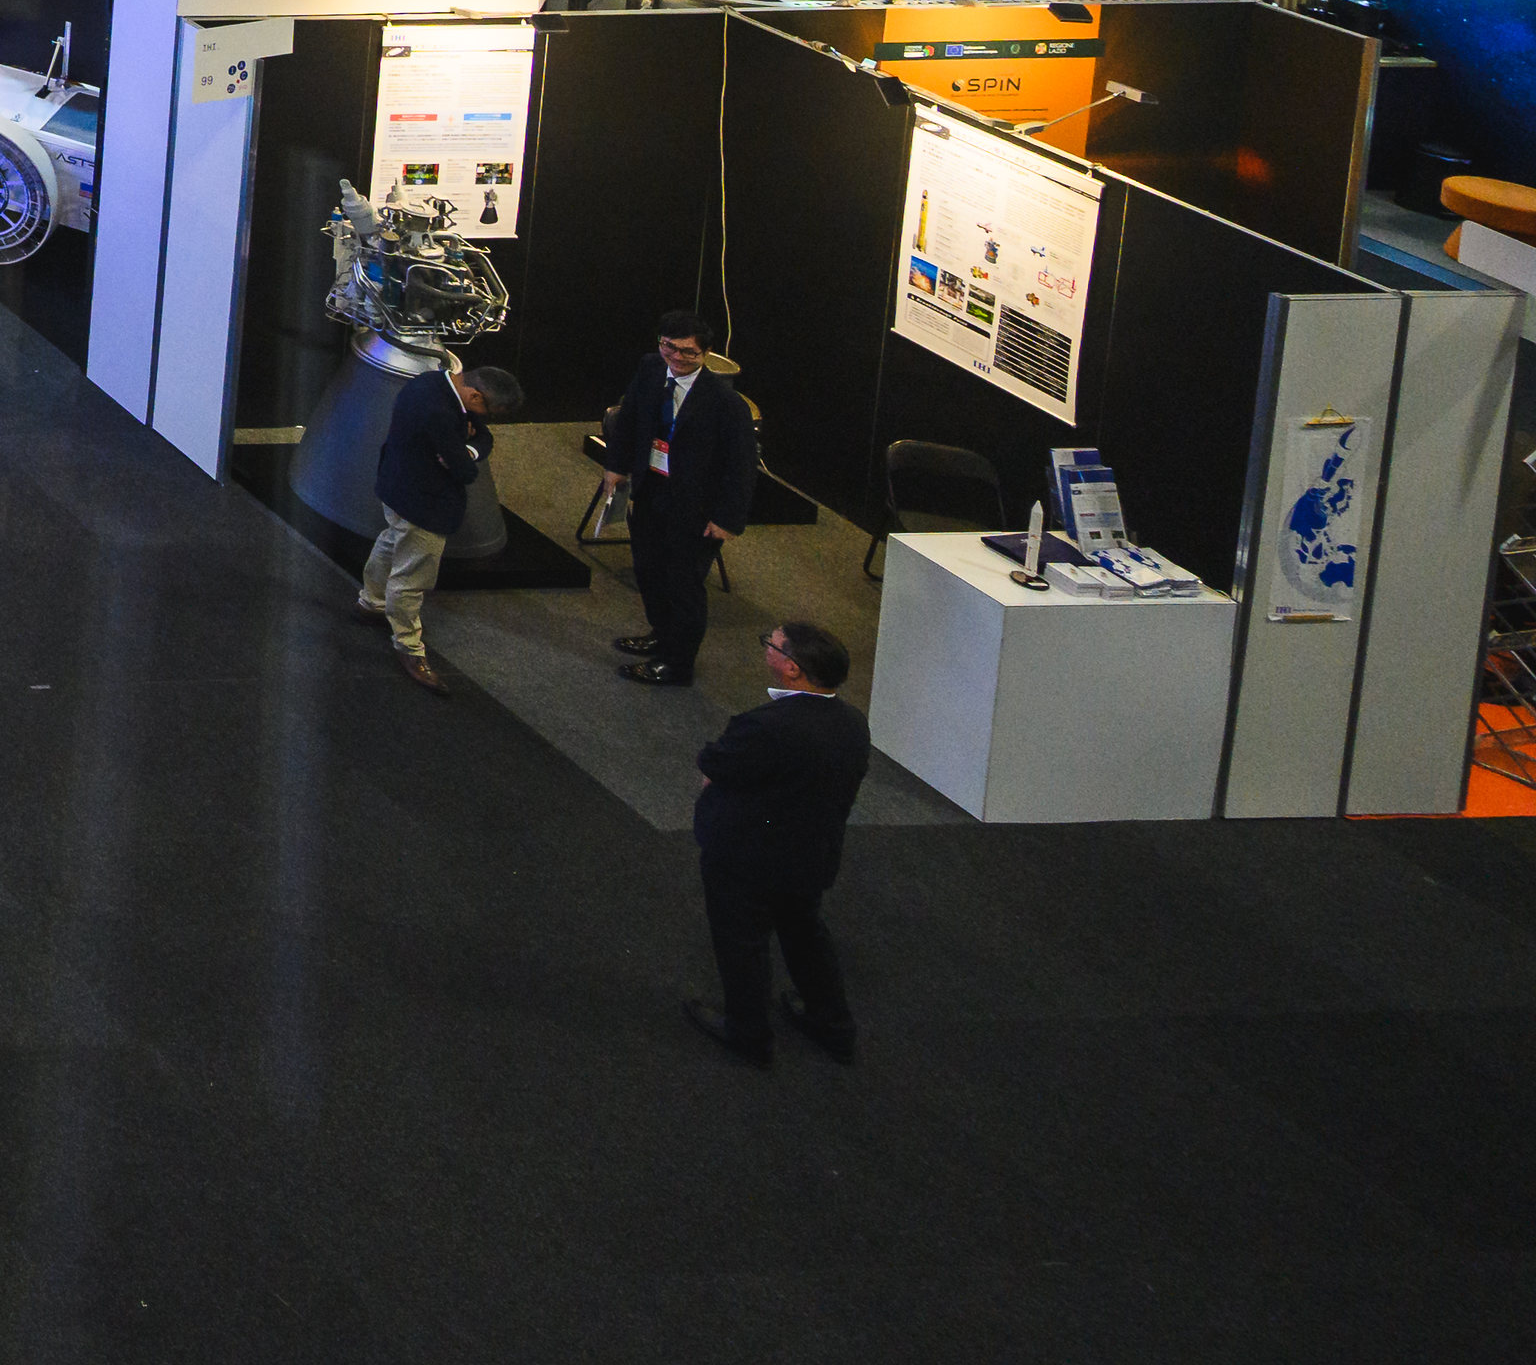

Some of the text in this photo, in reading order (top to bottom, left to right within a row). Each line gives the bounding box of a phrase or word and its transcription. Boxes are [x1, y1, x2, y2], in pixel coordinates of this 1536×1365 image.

[201, 76, 214, 86] 99
[967, 78, 1021, 91] SPIN
[972, 359, 992, 376] IHI
[1275, 605, 1291, 614] IHI
